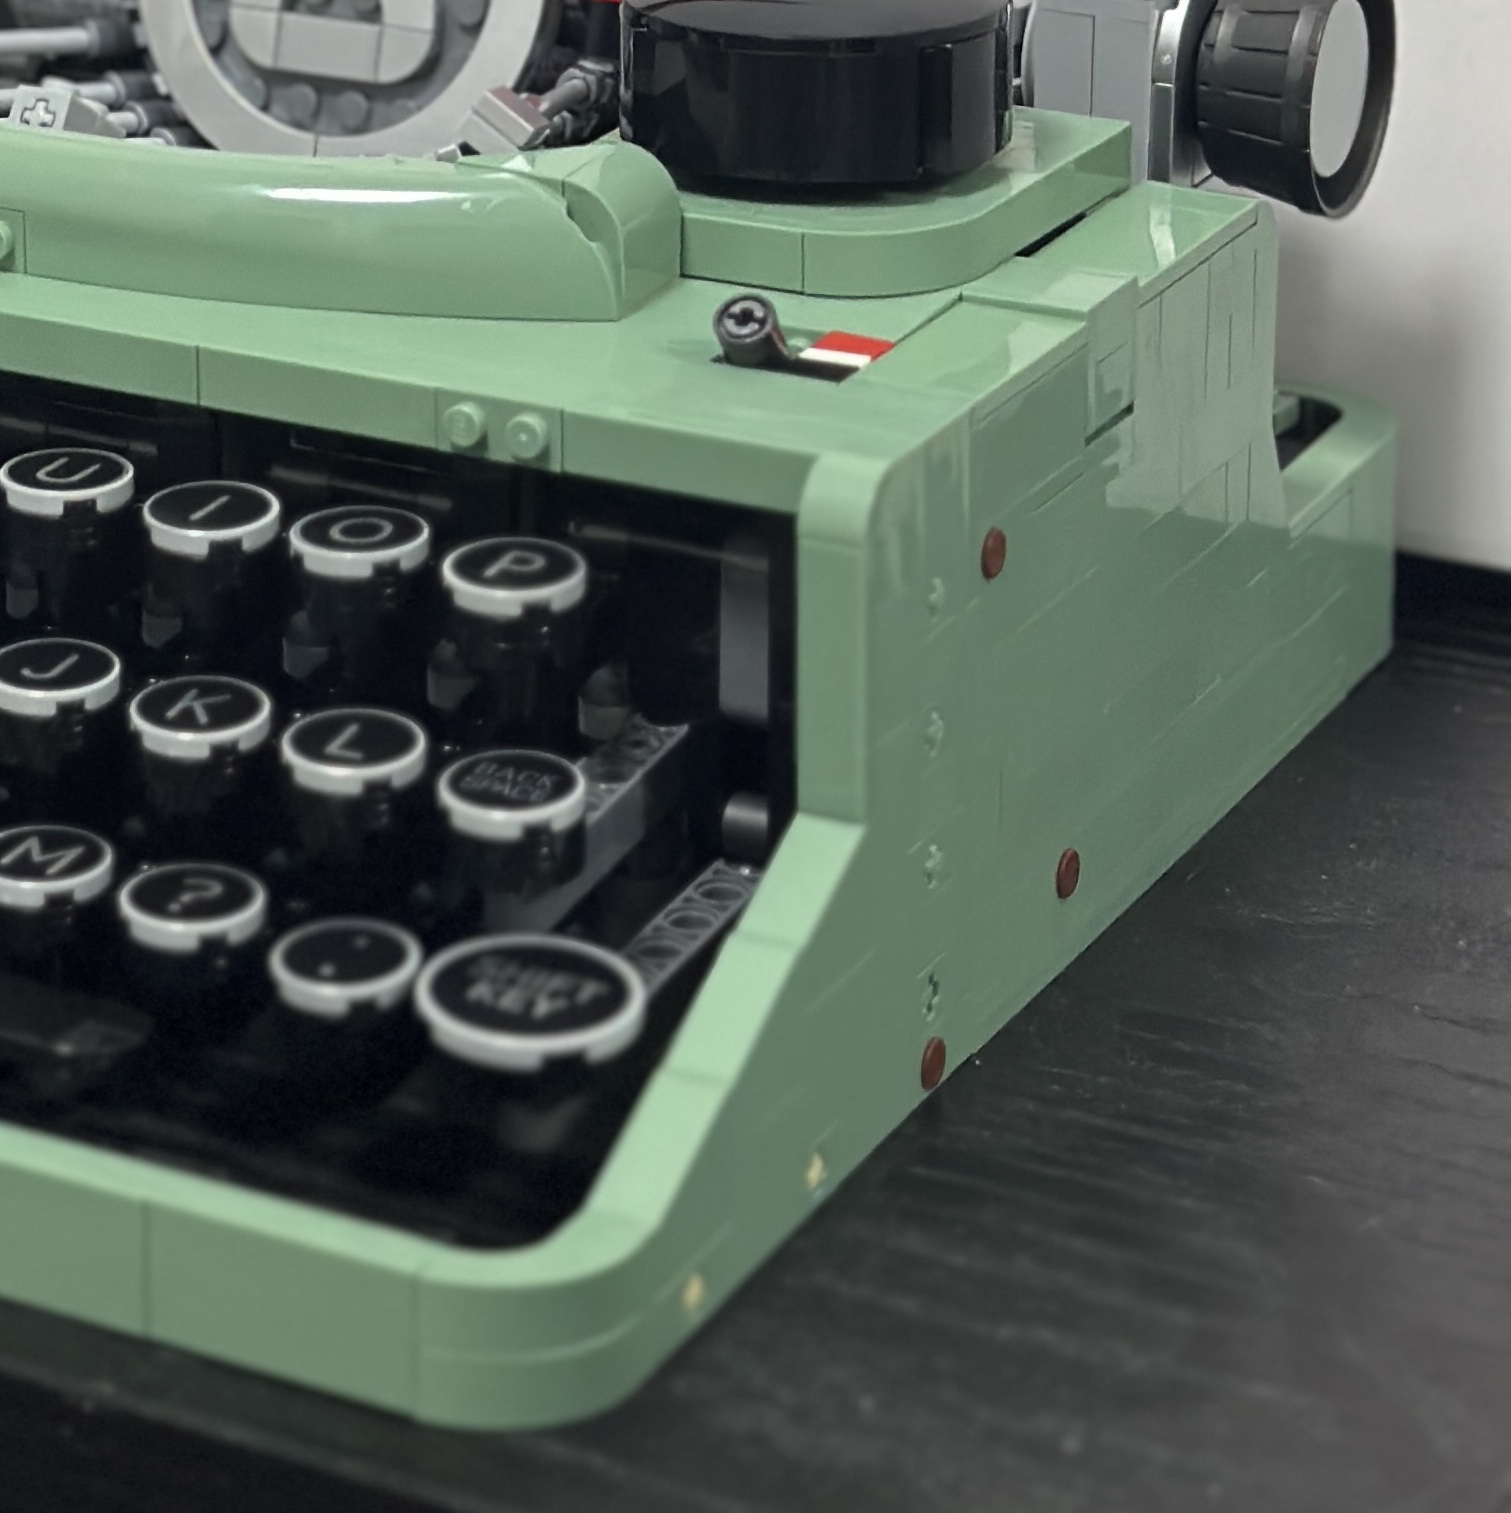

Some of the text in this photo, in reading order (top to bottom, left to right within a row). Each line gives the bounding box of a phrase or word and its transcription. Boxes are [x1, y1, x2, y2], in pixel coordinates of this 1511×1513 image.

[35, 457, 101, 484] U
[329, 517, 394, 545] O
[482, 550, 546, 579] P
[20, 653, 79, 680] J
[165, 689, 232, 726] K
[324, 723, 364, 761] L
[0, 836, 84, 876] M
